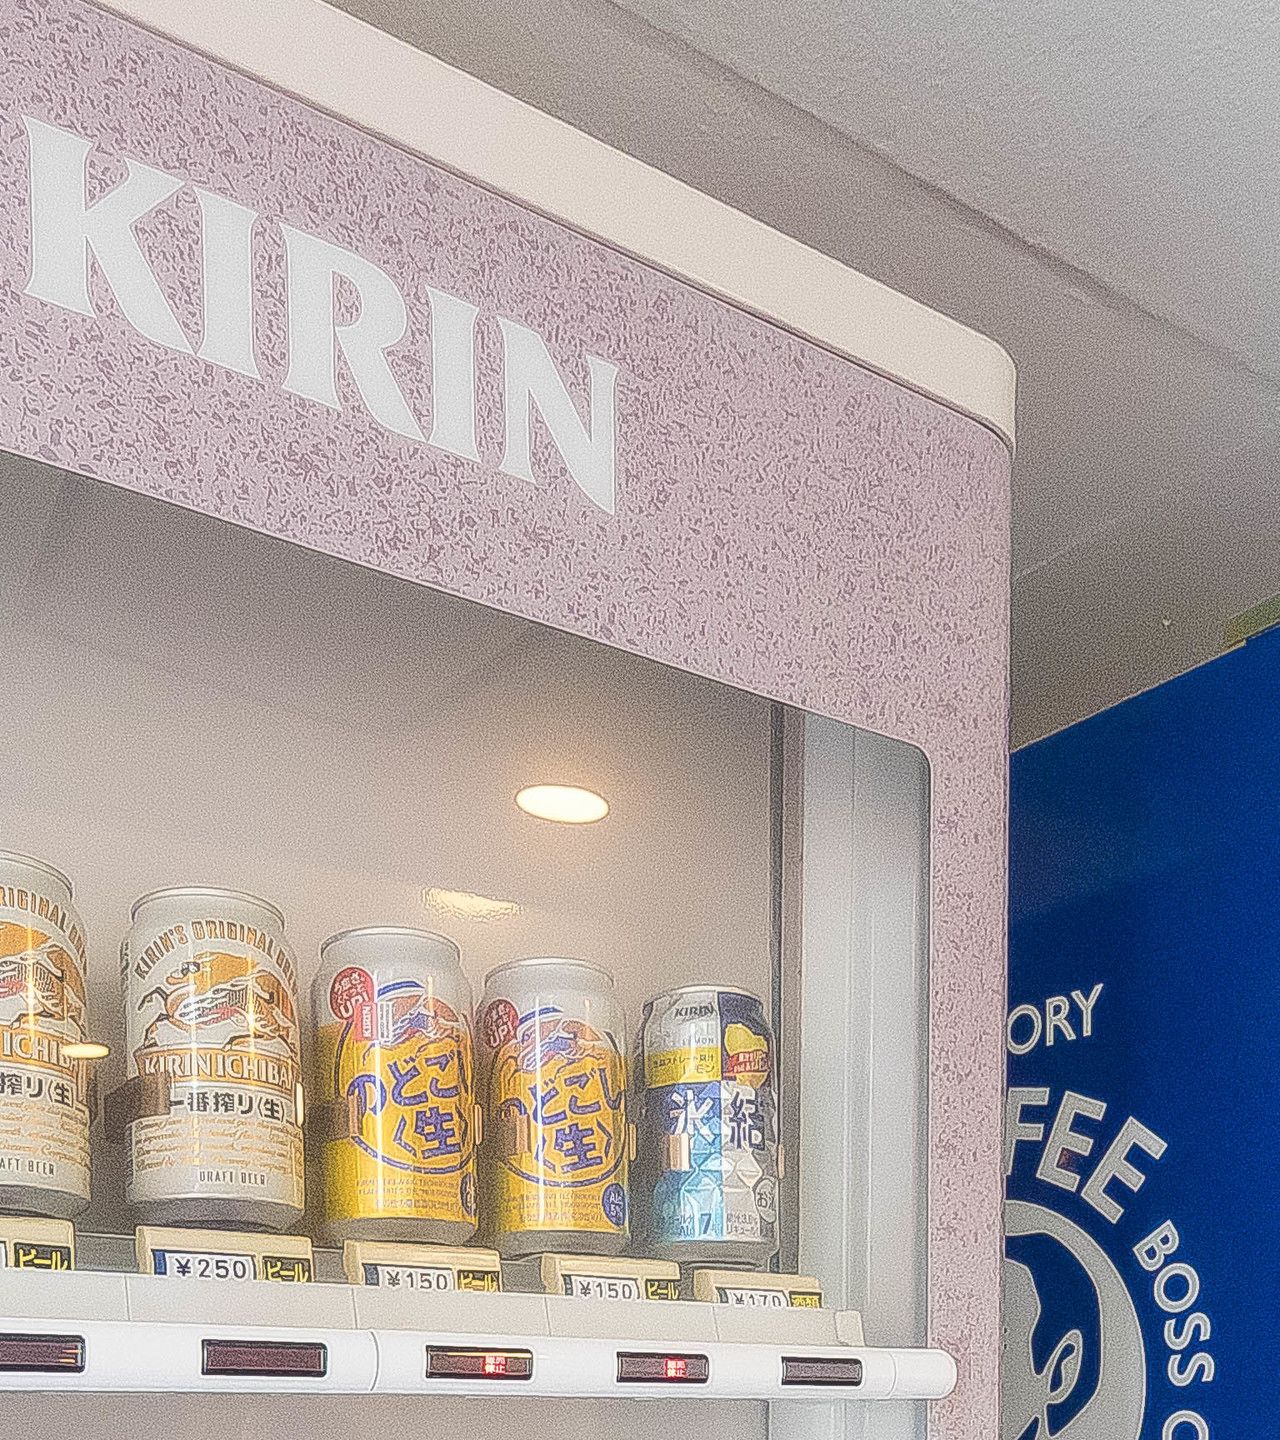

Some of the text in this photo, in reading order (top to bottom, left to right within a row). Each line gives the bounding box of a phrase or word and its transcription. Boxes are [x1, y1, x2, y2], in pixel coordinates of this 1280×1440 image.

[22, 114, 620, 516] KIRIN
[145, 1053, 214, 1077] KIRIN
[174, 1256, 311, 1283] ¥250 ビール
[386, 1270, 448, 1293] ¥150
[578, 1279, 634, 1300] ¥150
[1133, 1218, 1216, 1387] BOSS
